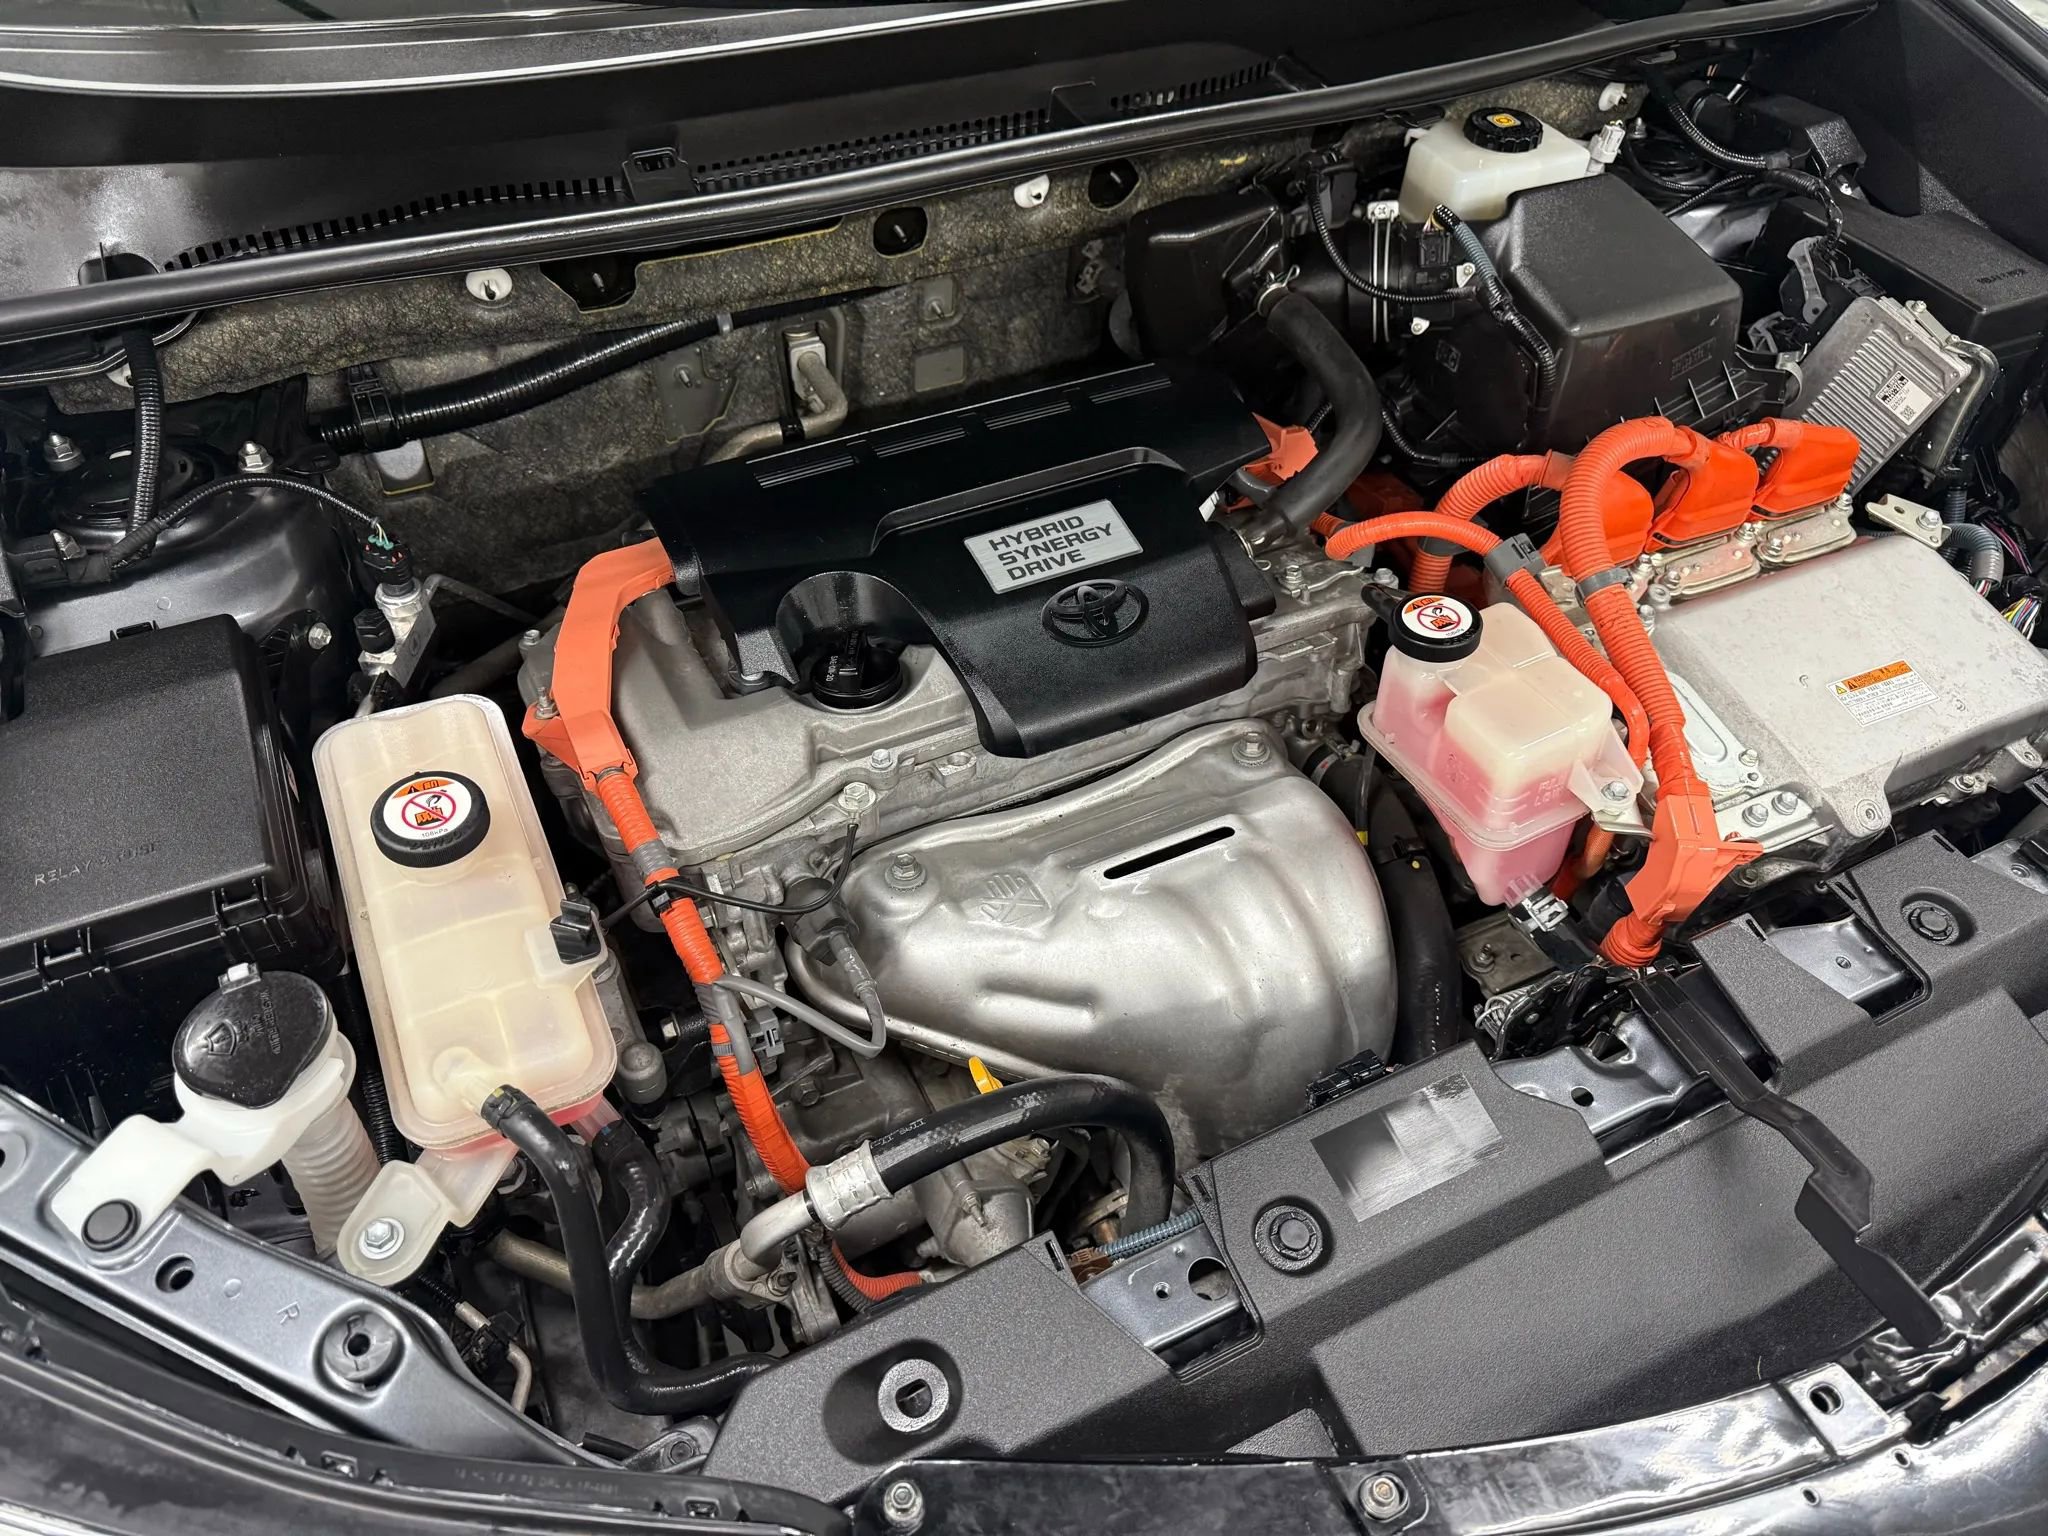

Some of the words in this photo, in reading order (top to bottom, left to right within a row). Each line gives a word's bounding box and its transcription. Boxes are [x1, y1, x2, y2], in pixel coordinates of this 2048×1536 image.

[988, 515, 1084, 551] HYBRID
[997, 522, 1113, 566] SYNERGY
[1007, 549, 1086, 581] DRIVE
[34, 860, 92, 886] RELAY
